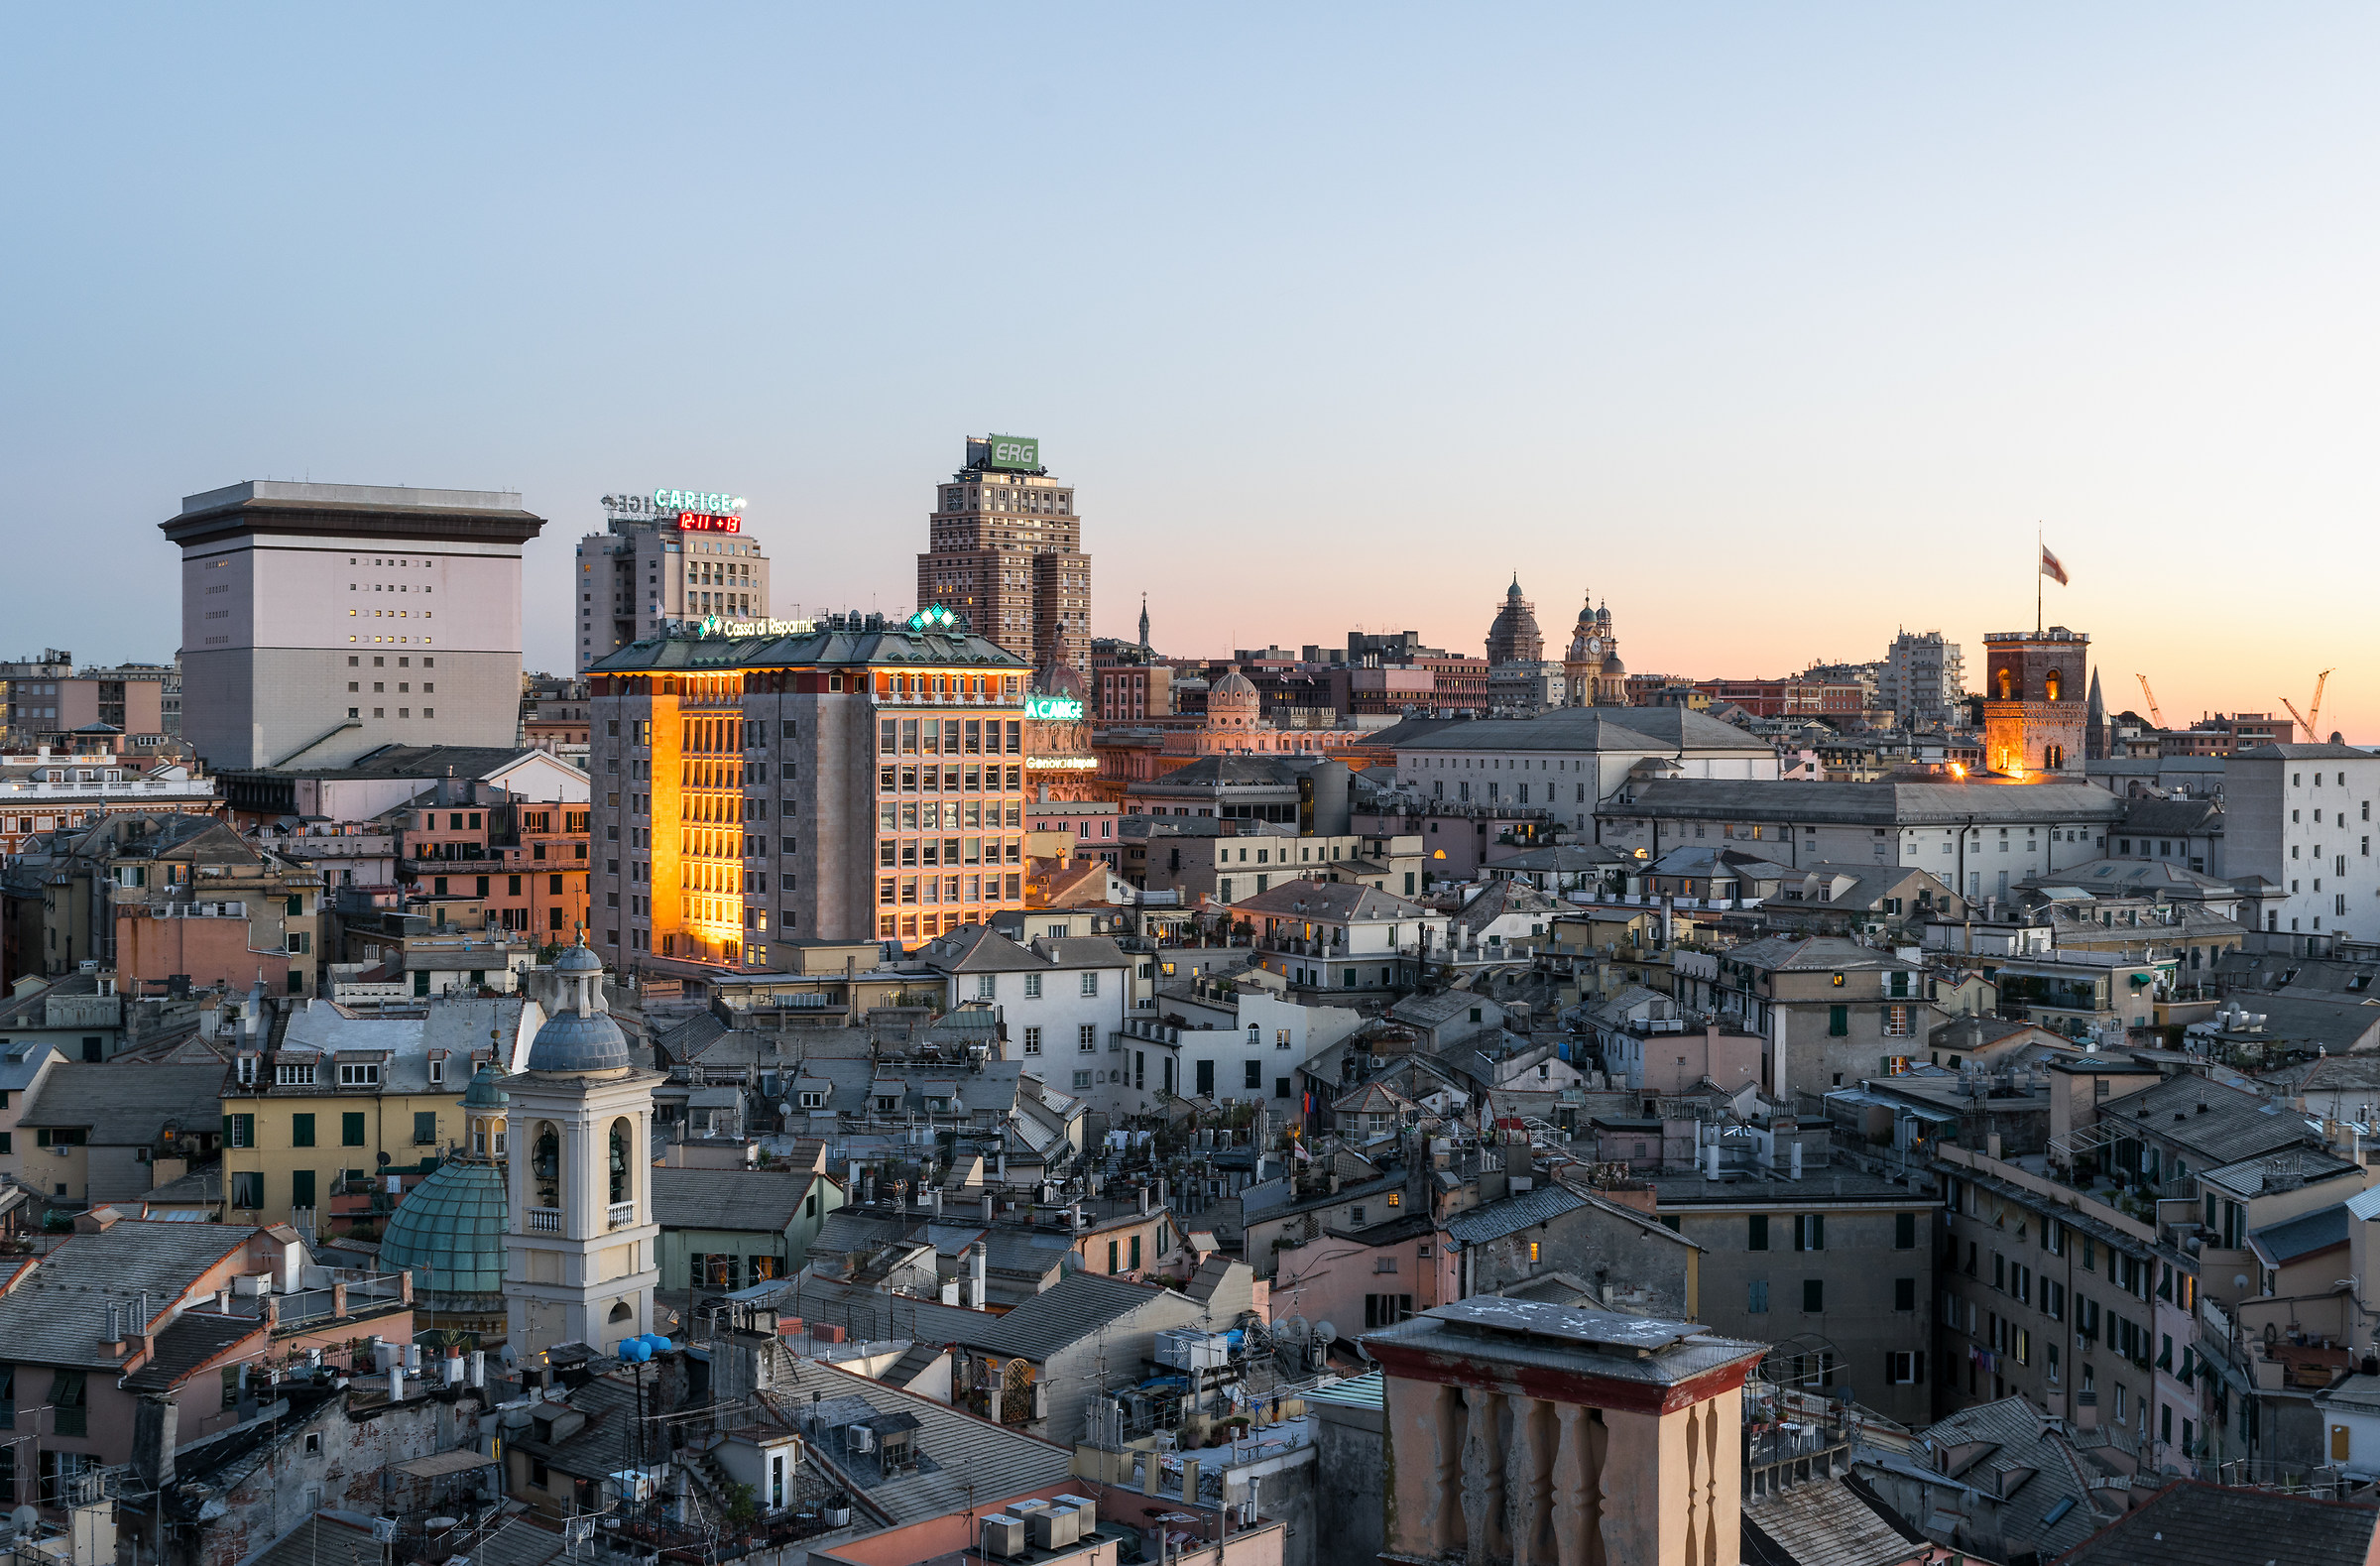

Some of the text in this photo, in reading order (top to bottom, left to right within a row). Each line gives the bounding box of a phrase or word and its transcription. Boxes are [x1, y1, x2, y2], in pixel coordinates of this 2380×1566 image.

[996, 442, 1034, 463] ERG
[655, 488, 730, 512] CARIGE
[725, 620, 755, 637] Cassa
[757, 619, 768, 636] di
[1038, 700, 1083, 719] CARIGE
[1026, 757, 1067, 770] Genova
